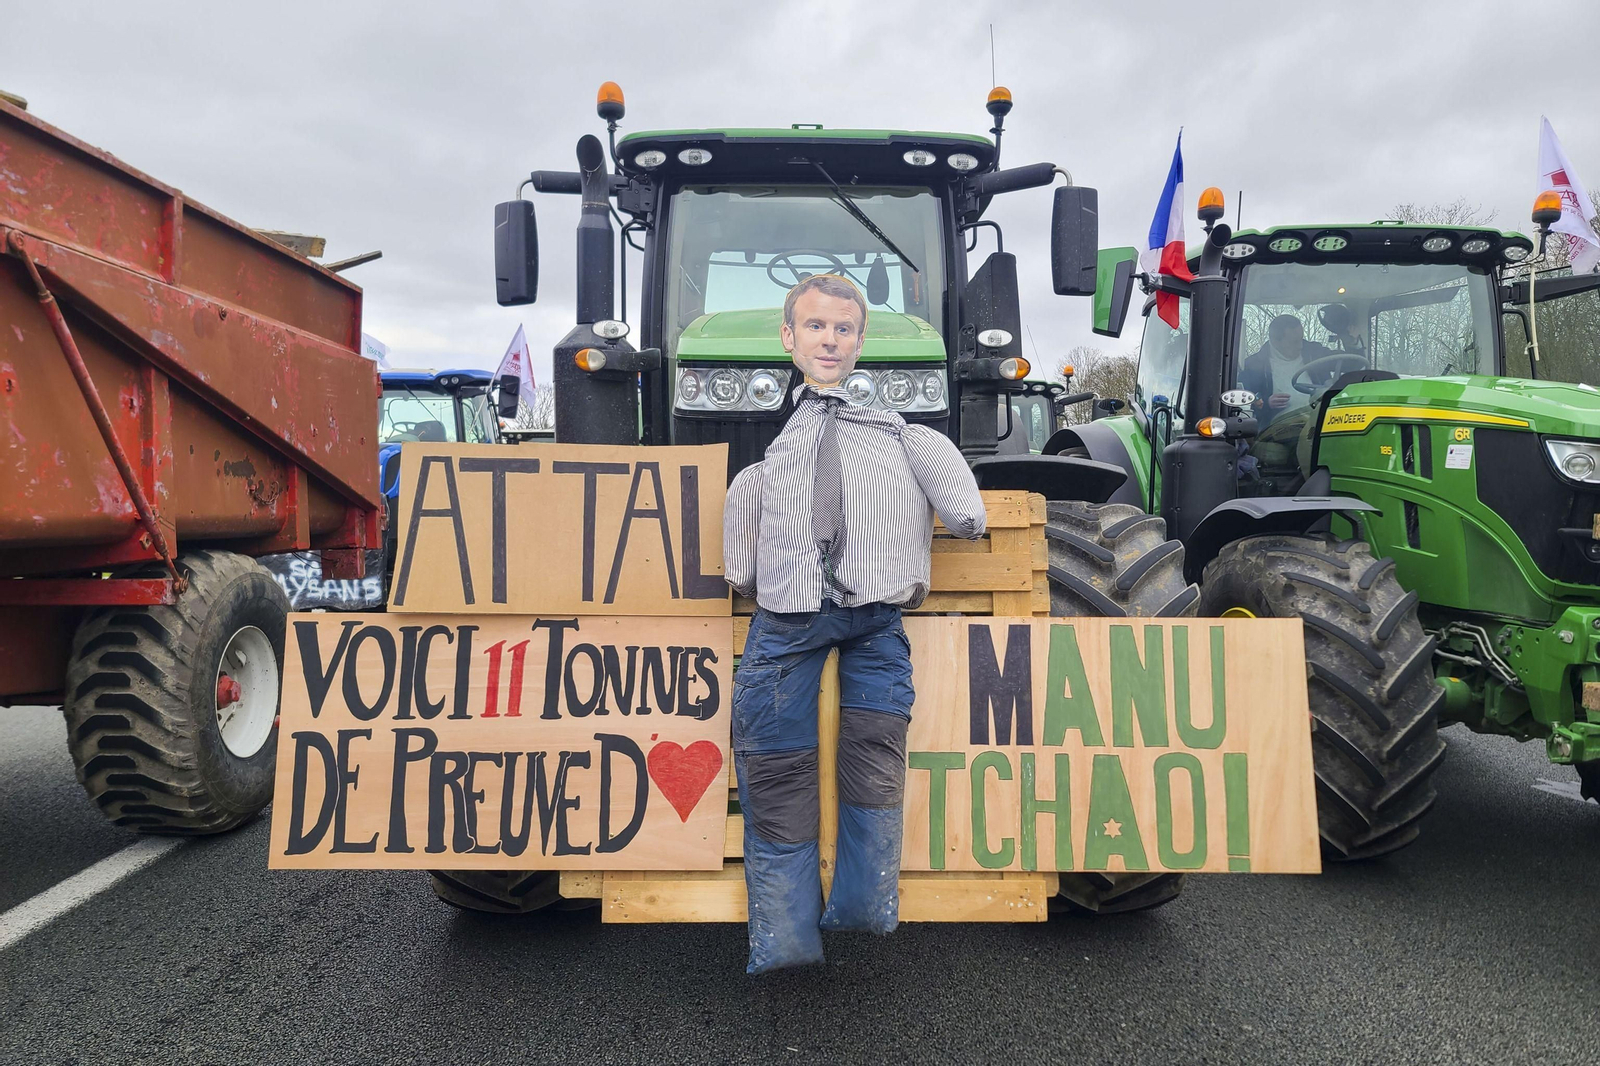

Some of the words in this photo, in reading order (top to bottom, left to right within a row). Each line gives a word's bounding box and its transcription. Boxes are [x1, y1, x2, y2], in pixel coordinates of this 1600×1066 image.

[1327, 414, 1343, 425] JOHN
[1343, 413, 1366, 424] DEERE
[1454, 427, 1471, 442] 6R
[393, 456, 729, 606] ATTAL
[293, 620, 479, 721] VOICI
[480, 639, 531, 718] 11
[968, 624, 1227, 749] MANU
[284, 728, 380, 855] DE
[384, 727, 593, 857] PREUVE
[908, 751, 1251, 873] TCHAO!
